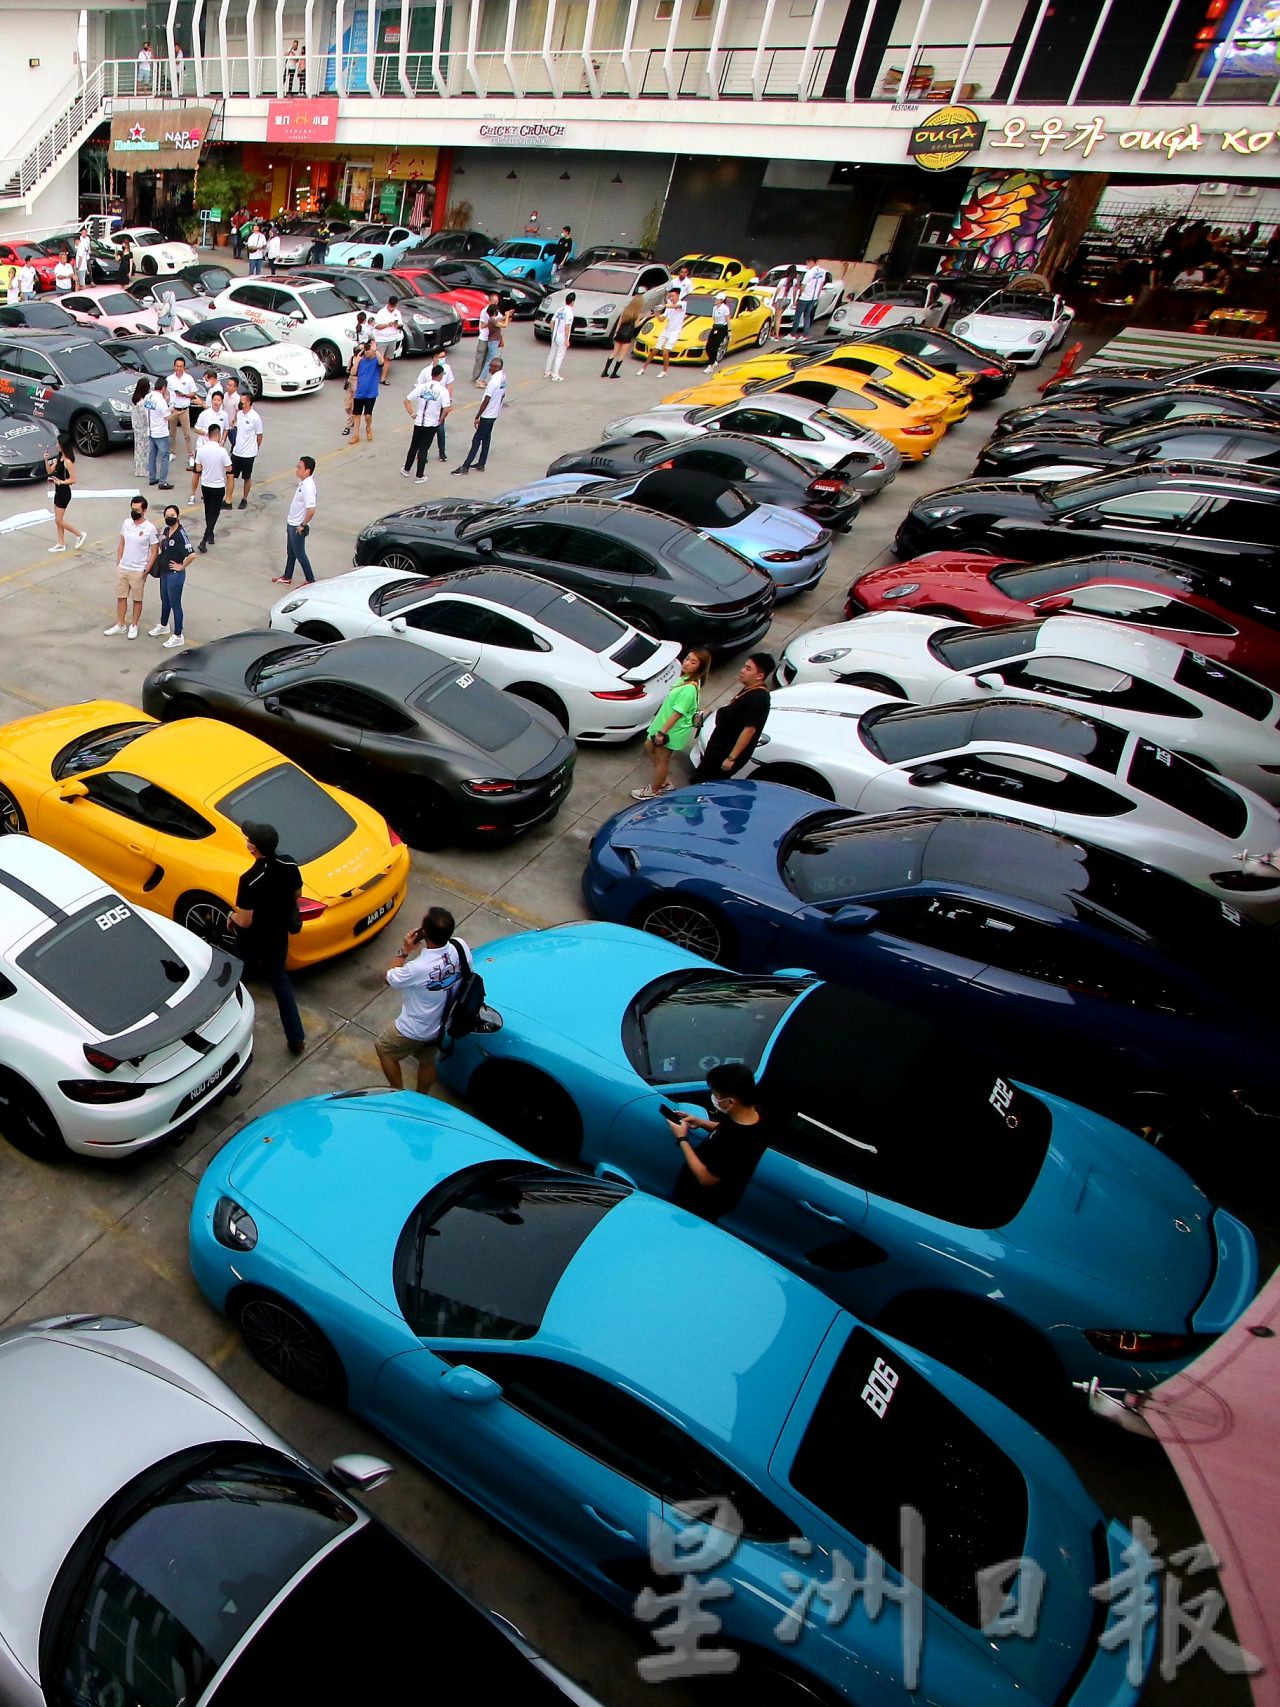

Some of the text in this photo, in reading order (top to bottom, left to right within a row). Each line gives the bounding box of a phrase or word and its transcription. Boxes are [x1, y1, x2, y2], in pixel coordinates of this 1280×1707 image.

[890, 104, 920, 112] RESTORAN
[165, 131, 189, 142] NAP
[479, 124, 566, 137] CHICKY CRUNCH
[915, 126, 977, 145] OUGA
[989, 117, 1108, 158] 오우가
[175, 140, 200, 150] NAP
[1119, 123, 1204, 160] OUGA
[244, 309, 263, 318] RACE
[455, 672, 475, 689] B07
[95, 904, 132, 931] B05
[988, 1078, 1014, 1117] F02
[861, 1357, 899, 1419] B06
